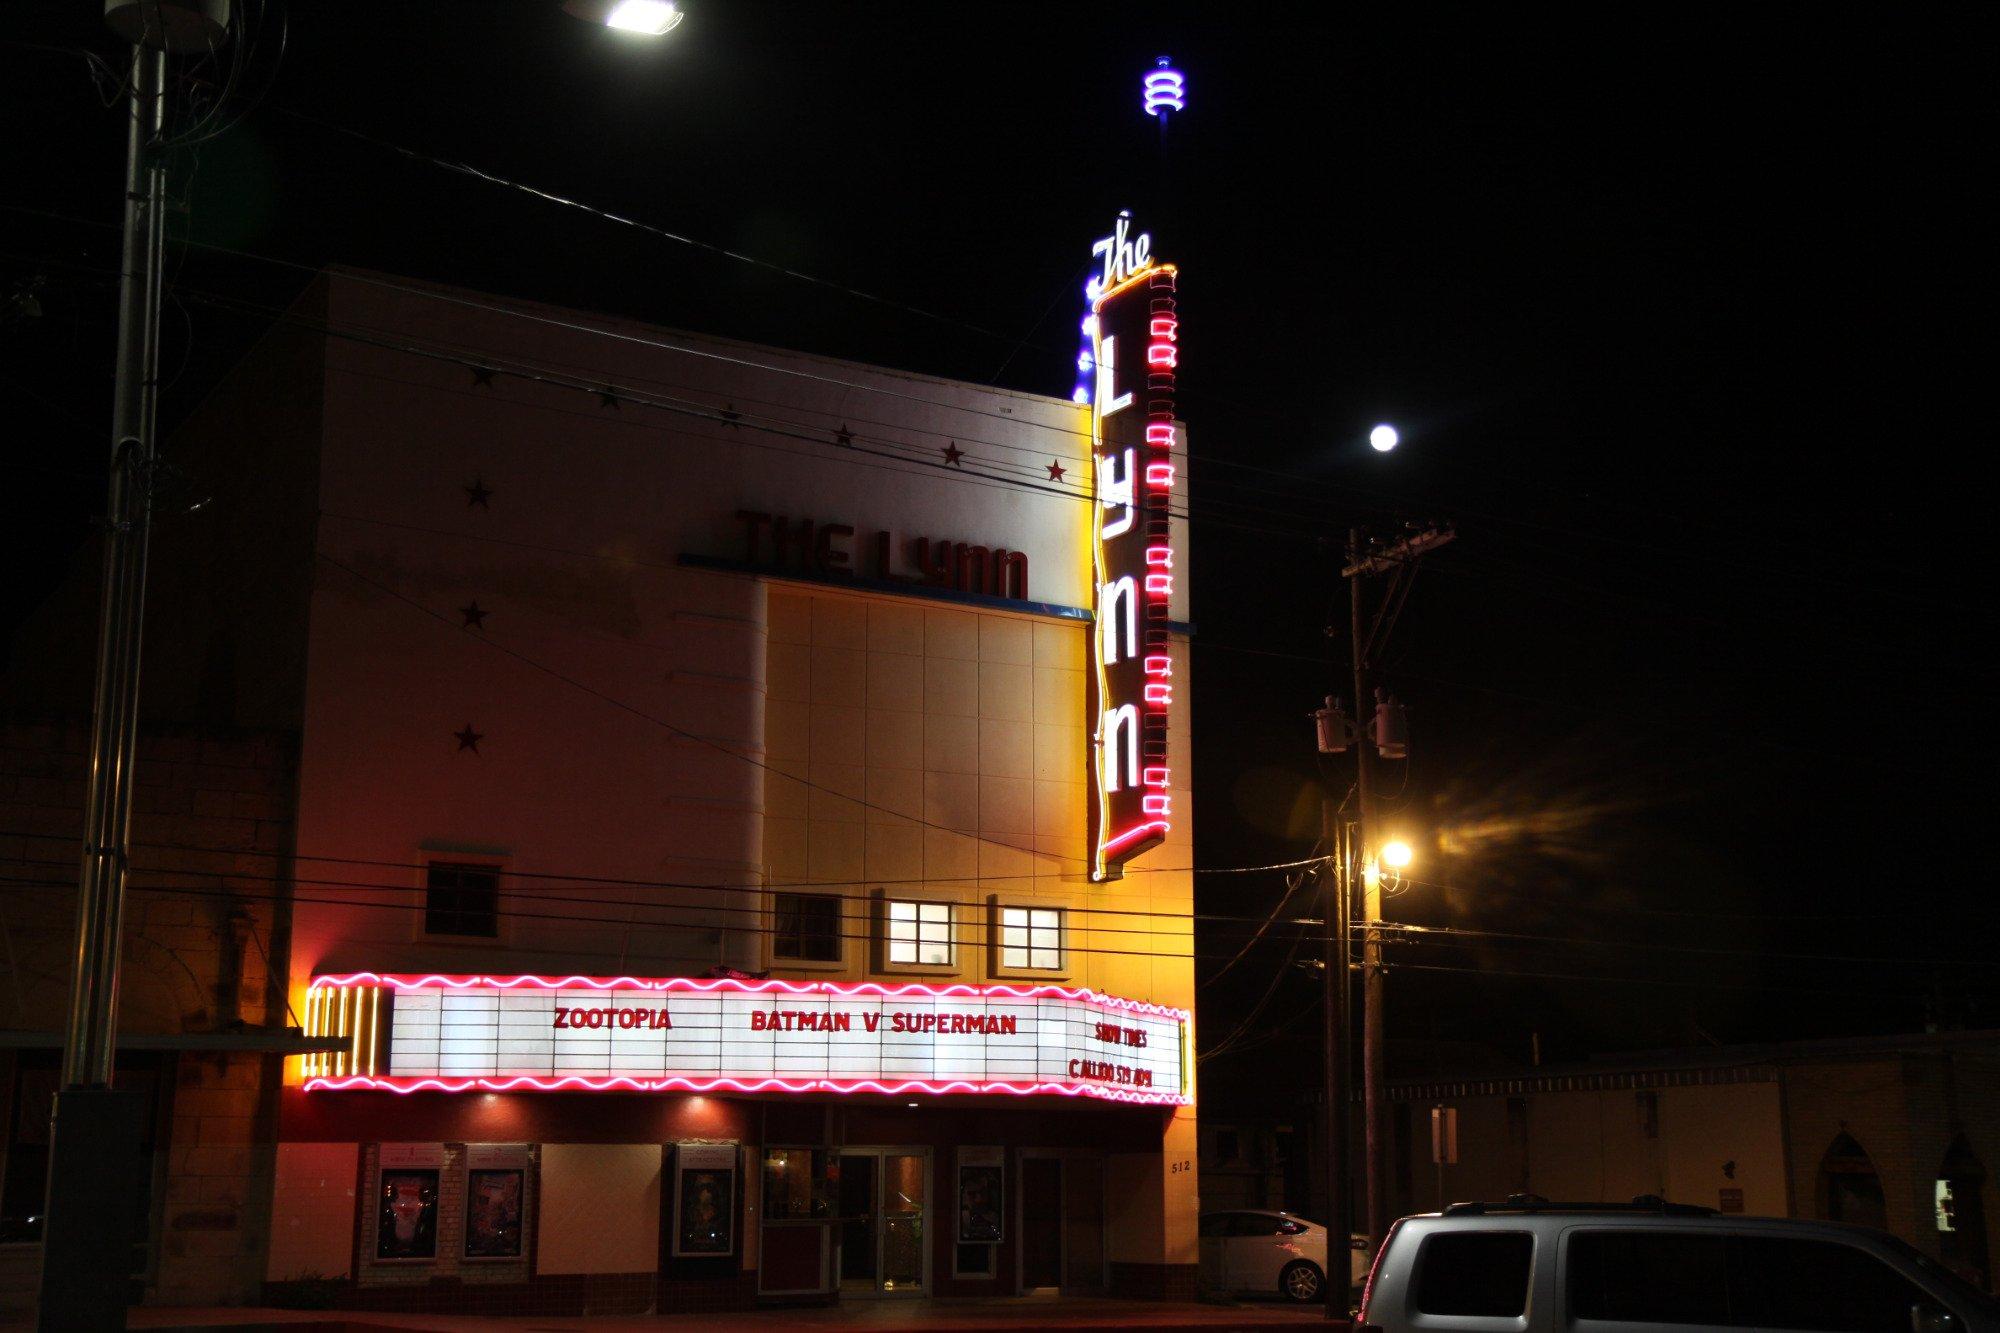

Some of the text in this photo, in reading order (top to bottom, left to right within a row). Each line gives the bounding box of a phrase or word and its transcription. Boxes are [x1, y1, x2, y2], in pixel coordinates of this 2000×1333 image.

[1093, 210, 1153, 291] The
[736, 510, 854, 577] THE
[553, 1007, 672, 1030] ZOOTOPIA
[751, 1010, 1017, 1035] BATMAN V SUPERMAN
[1172, 1160, 1190, 1174] 512
